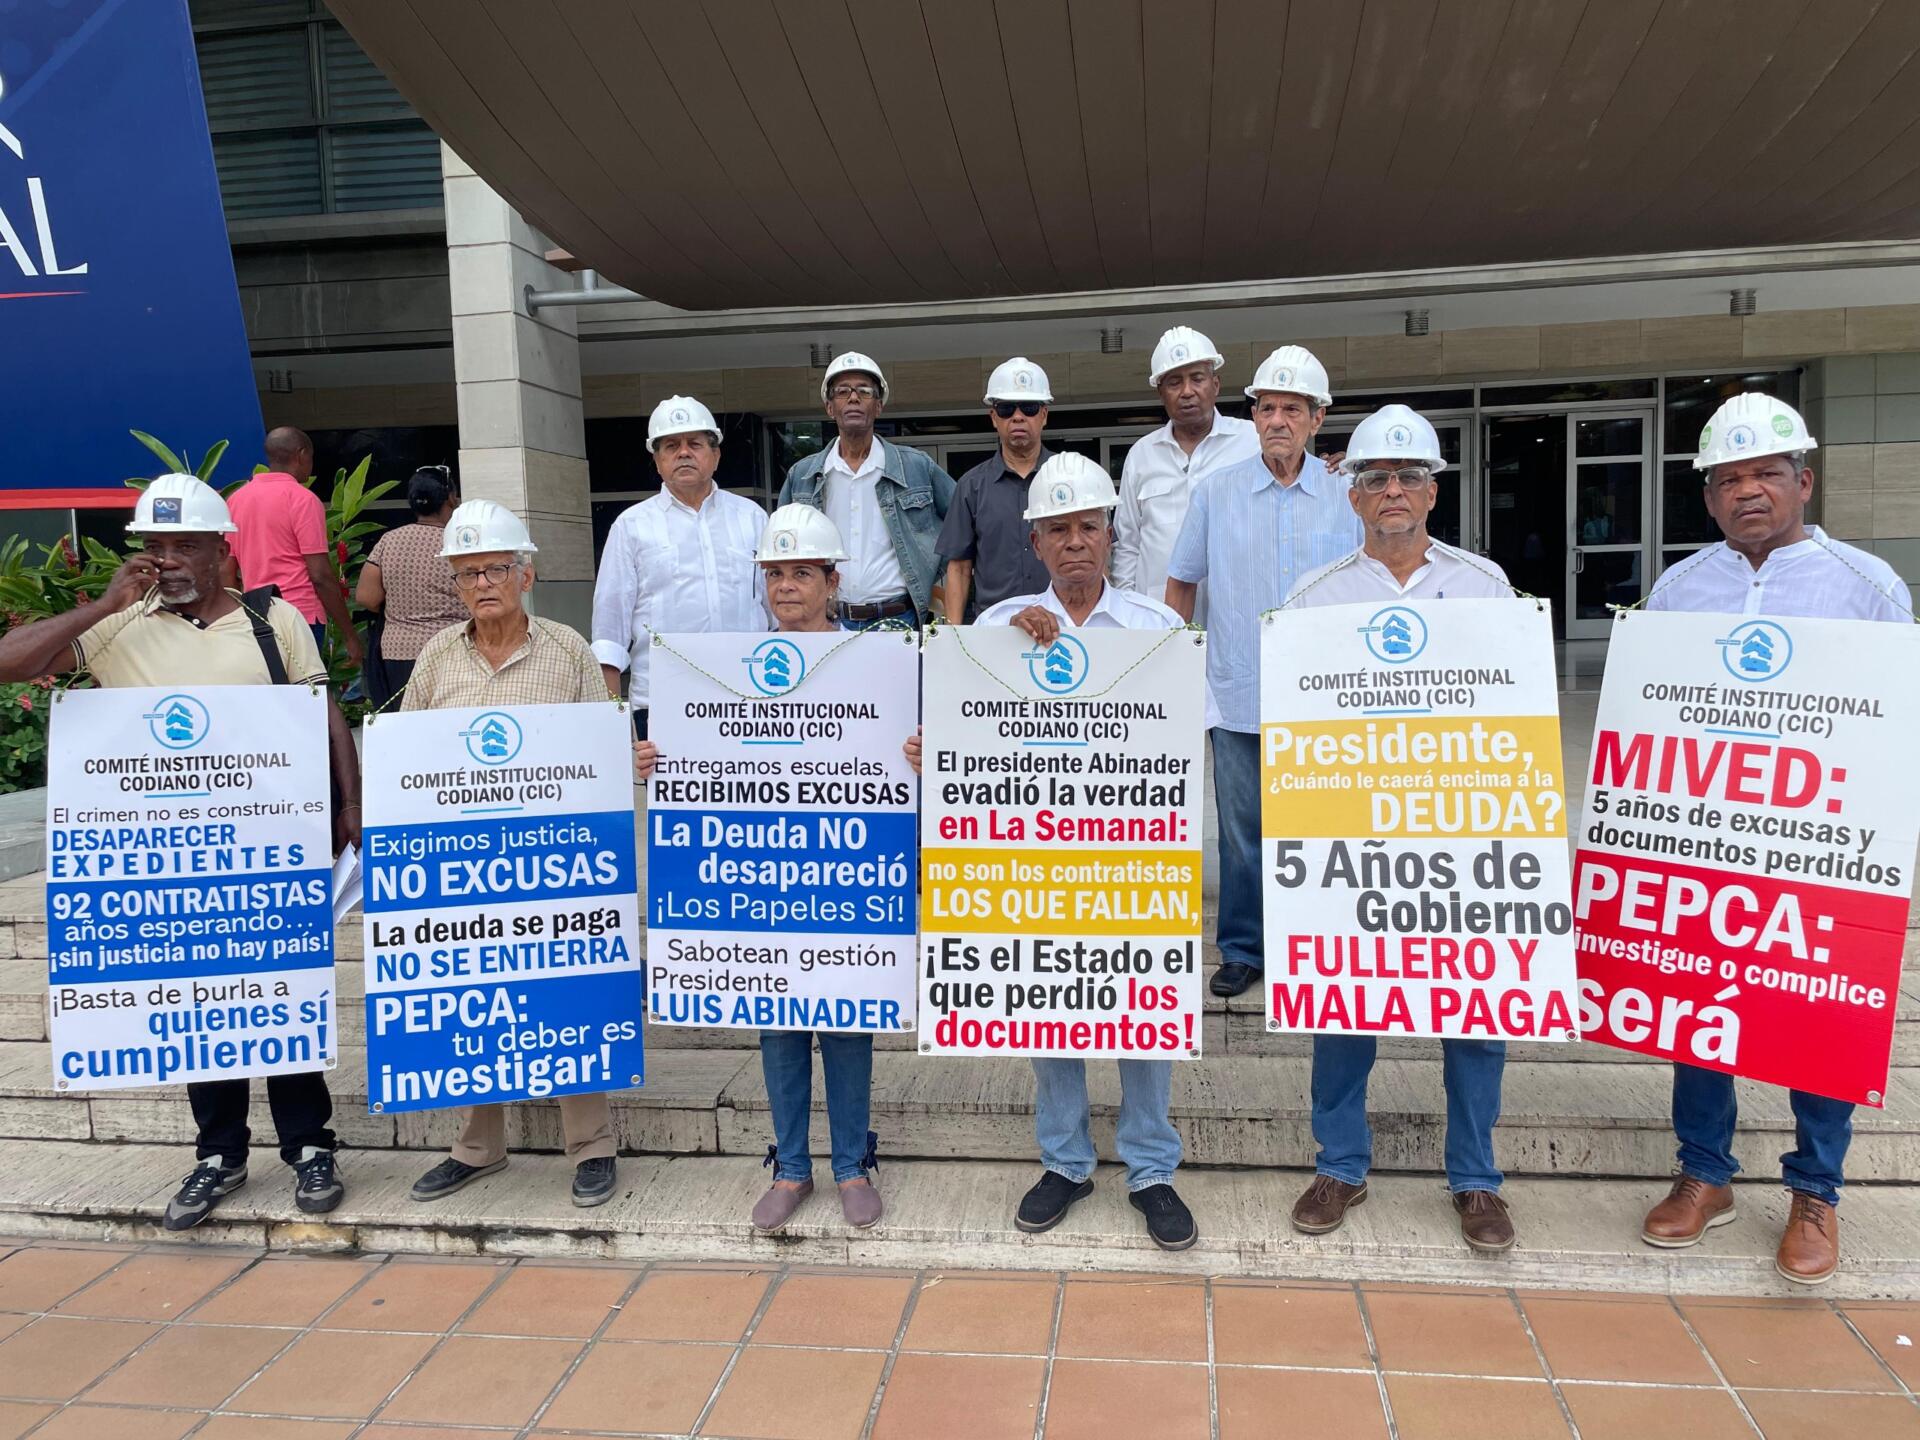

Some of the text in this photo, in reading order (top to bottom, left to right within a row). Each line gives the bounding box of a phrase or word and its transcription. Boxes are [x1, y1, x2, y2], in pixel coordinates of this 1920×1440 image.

[1299, 668, 1515, 691] COMITÉ INSTITUCIONAL
[1337, 688, 1475, 709] CODIANO (CIC)
[685, 700, 879, 719] COMITÉ INSTITUCIONAL
[1034, 701, 1167, 720] INSTITUCIONAL
[1642, 683, 1884, 718] COMITÉ INSTITUCIONAL
[719, 722, 842, 741] CODIANO (CIC)
[999, 721, 1129, 742] CODIANO (CIC)
[1679, 706, 1833, 739] CODIANO (CIC)
[84, 753, 291, 774] COMITÉ INSTITUCIONAL
[937, 752, 1190, 777] El presidente Abinader
[1266, 722, 1534, 771] Presidente,
[120, 772, 253, 792] CODIANO (CIC)
[400, 764, 597, 789] COMITÉ INSTITUCIONAL
[655, 754, 889, 779] Entregamos escuelas,
[1269, 770, 1352, 793] ¿Cuándo
[1357, 772, 1373, 789] le
[1378, 771, 1434, 788] caerá
[1439, 770, 1511, 788] encima
[1535, 770, 1553, 787] la
[1592, 730, 1847, 814] MIVED:
[437, 784, 562, 806] CODIANO (CIC)
[655, 780, 910, 805] RECIBIMOS EXCUSAS
[942, 776, 1185, 806] evadió la verdad
[54, 800, 324, 823] El crimen no es construir, es
[939, 810, 1188, 842] en La Semanal:
[1372, 791, 1562, 833] DEUDA?
[1592, 791, 1876, 854] 5 años de excusas y
[53, 824, 236, 851] DESAPARECER
[370, 822, 598, 861] Exigimos justicia,
[655, 815, 867, 849] La Deuda NO
[53, 844, 305, 877] EXPEDIENTES
[699, 852, 908, 891] desapareció
[928, 859, 1192, 883] no son los contratistas
[1275, 839, 1541, 890] 5 Años de
[1588, 821, 1900, 887] documentos perdidos
[372, 851, 618, 902] NO EXCUSAS
[53, 880, 326, 919] 92 CONTRATISTAS
[657, 892, 904, 926] ¡Los Papeles Sí!
[933, 888, 1199, 927] LOS QUE FALLAN,
[1356, 890, 1572, 935] Gobierno
[1575, 862, 1834, 964] PEPCA:
[65, 919, 128, 942] años
[373, 908, 620, 948] La deuda se paga
[51, 932, 329, 975] ¡sin justicia no hay país!
[376, 936, 630, 982] NO SE ENTIERRA
[667, 938, 896, 970] Sabotean gestión
[926, 938, 1193, 979] ¡Es el Estado el
[1288, 935, 1540, 981] FULLERO Y
[1575, 928, 1886, 1009] investigue o complice
[53, 978, 289, 1016] ¡Basta de burla a
[652, 967, 788, 992] Presidente
[929, 976, 1178, 1016] que perdió los
[149, 991, 328, 1041] quienes sí
[376, 987, 527, 1036] PEPCA:
[653, 993, 900, 1029] LUIS ABINADER
[1272, 983, 1577, 1037] MALA PAGA
[1577, 978, 1741, 1066] será
[453, 1019, 636, 1057] tu deber es
[936, 1011, 1194, 1050] documentos!
[62, 1025, 327, 1081] cumplieron!
[381, 1043, 611, 1102] investigar!
